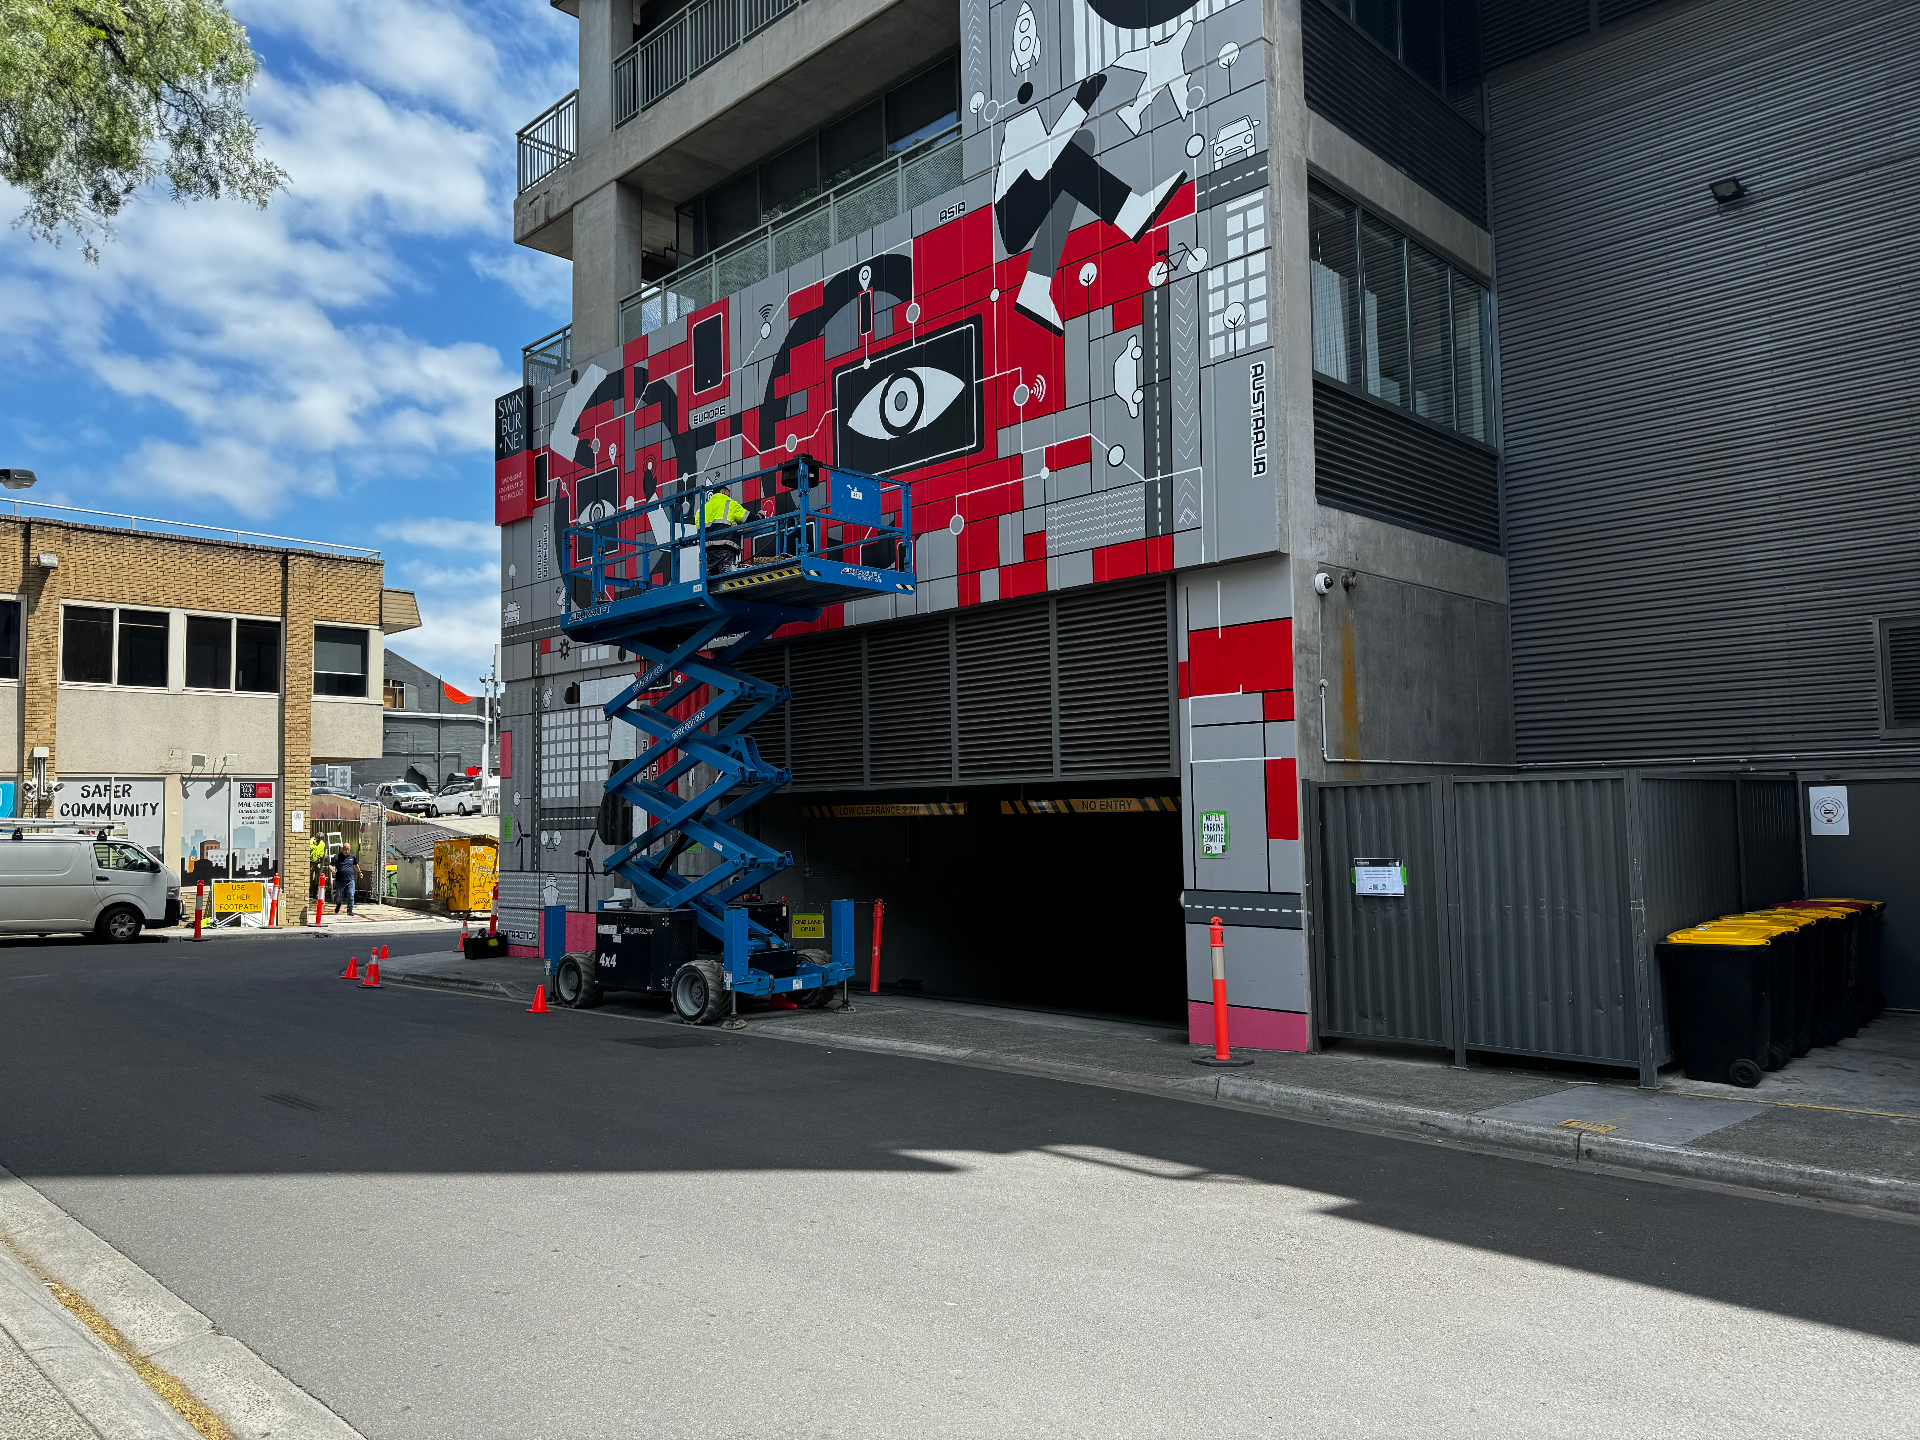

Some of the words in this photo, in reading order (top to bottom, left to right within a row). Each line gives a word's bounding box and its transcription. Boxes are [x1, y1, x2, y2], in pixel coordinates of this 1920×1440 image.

[939, 200, 966, 223] ASIA
[693, 404, 726, 425] EUROPE
[1250, 361, 1267, 477] AUSTRALIA
[501, 412, 522, 436] BUR
[80, 784, 132, 798] SAFER
[60, 802, 159, 817] COMMUNITY
[840, 806, 854, 815] LOW
[856, 805, 901, 815] CLEARANCE
[1082, 800, 1097, 811] NO
[1099, 799, 1132, 810] ENTRY
[226, 893, 251, 901] OTHER
[219, 903, 259, 911] FOOTPATH
[599, 952, 617, 968] 4x4
